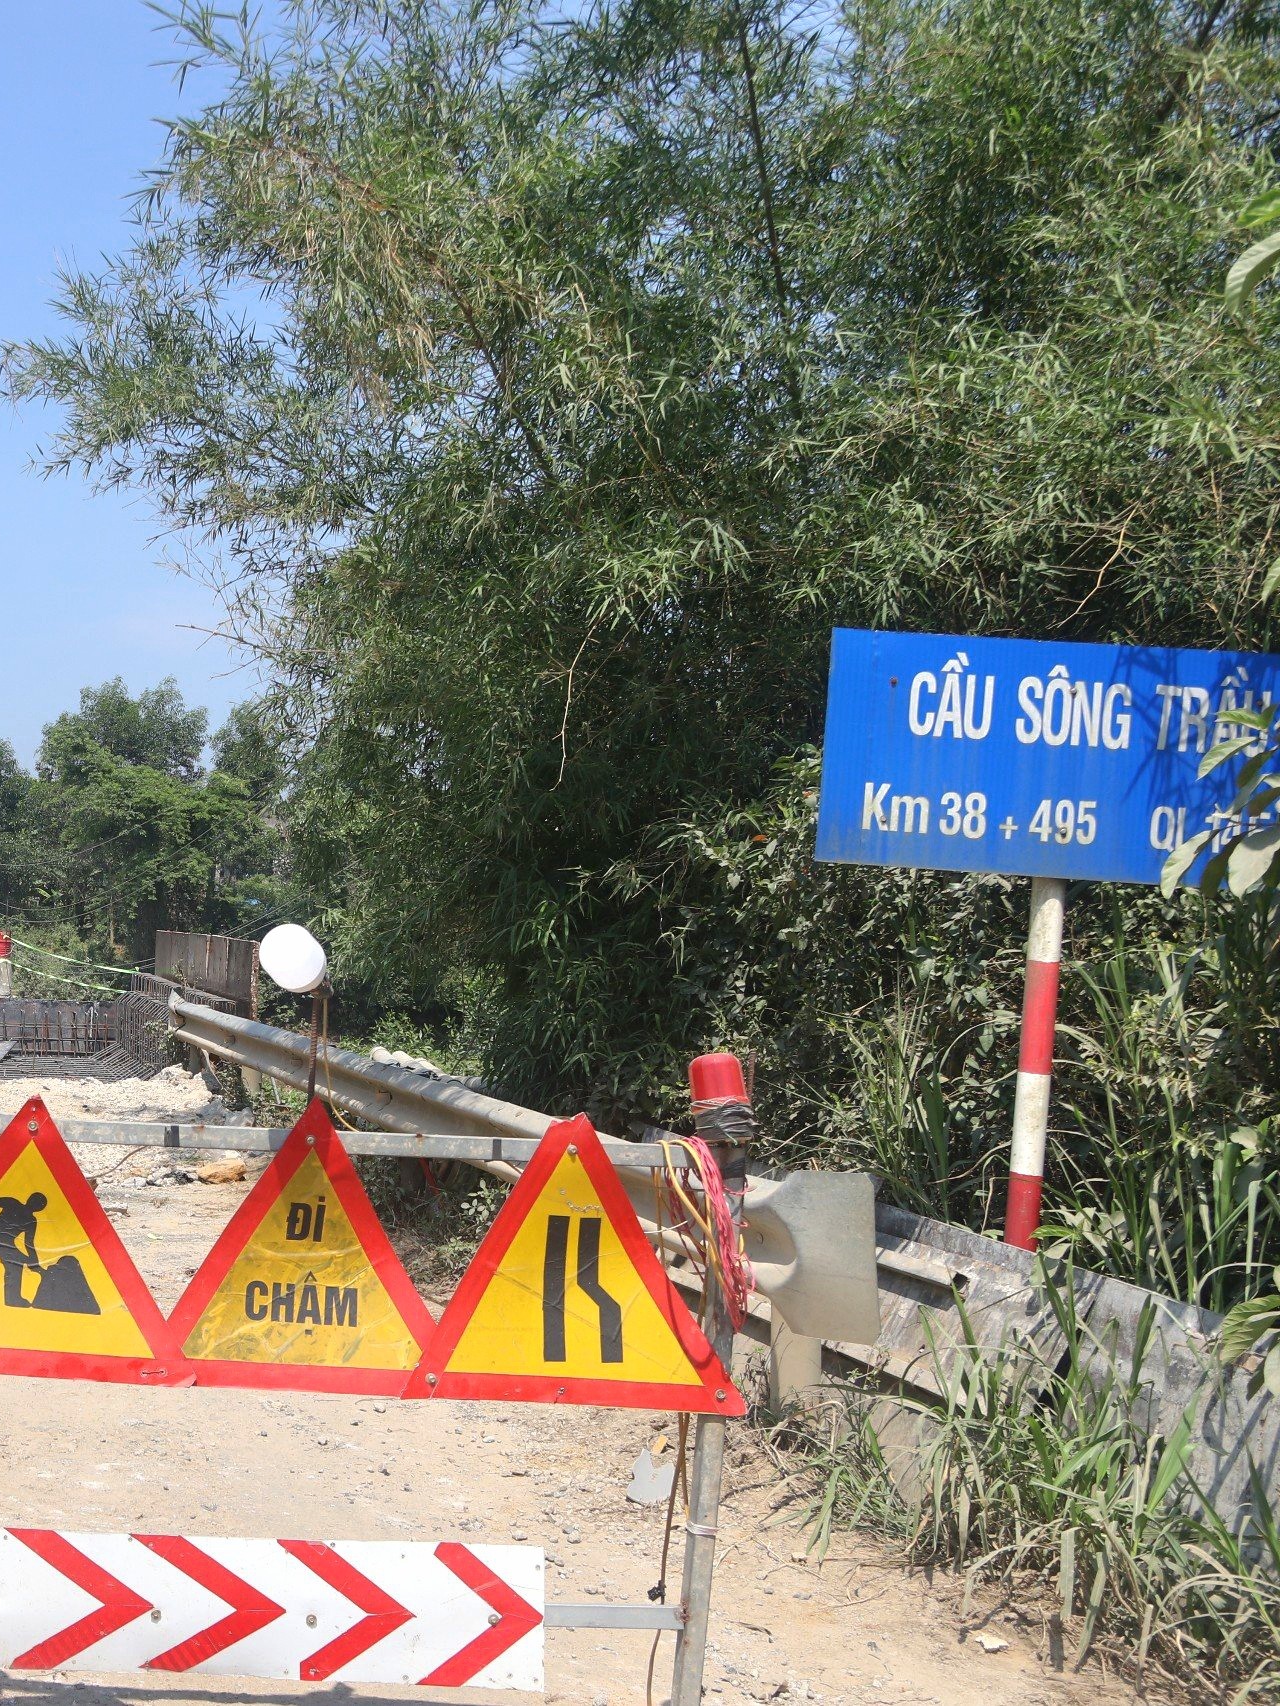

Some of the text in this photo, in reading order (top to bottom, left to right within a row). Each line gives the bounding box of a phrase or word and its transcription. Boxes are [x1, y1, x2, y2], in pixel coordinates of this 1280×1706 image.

[908, 652, 995, 740] CẦU
[1015, 664, 1133, 751] SÔNG
[861, 782, 930, 834] Km
[939, 791, 987, 840] 38
[999, 816, 1019, 840] +
[1029, 799, 1097, 846] 495
[285, 1196, 327, 1243] ĐI
[244, 1270, 358, 1336] CHẬM
